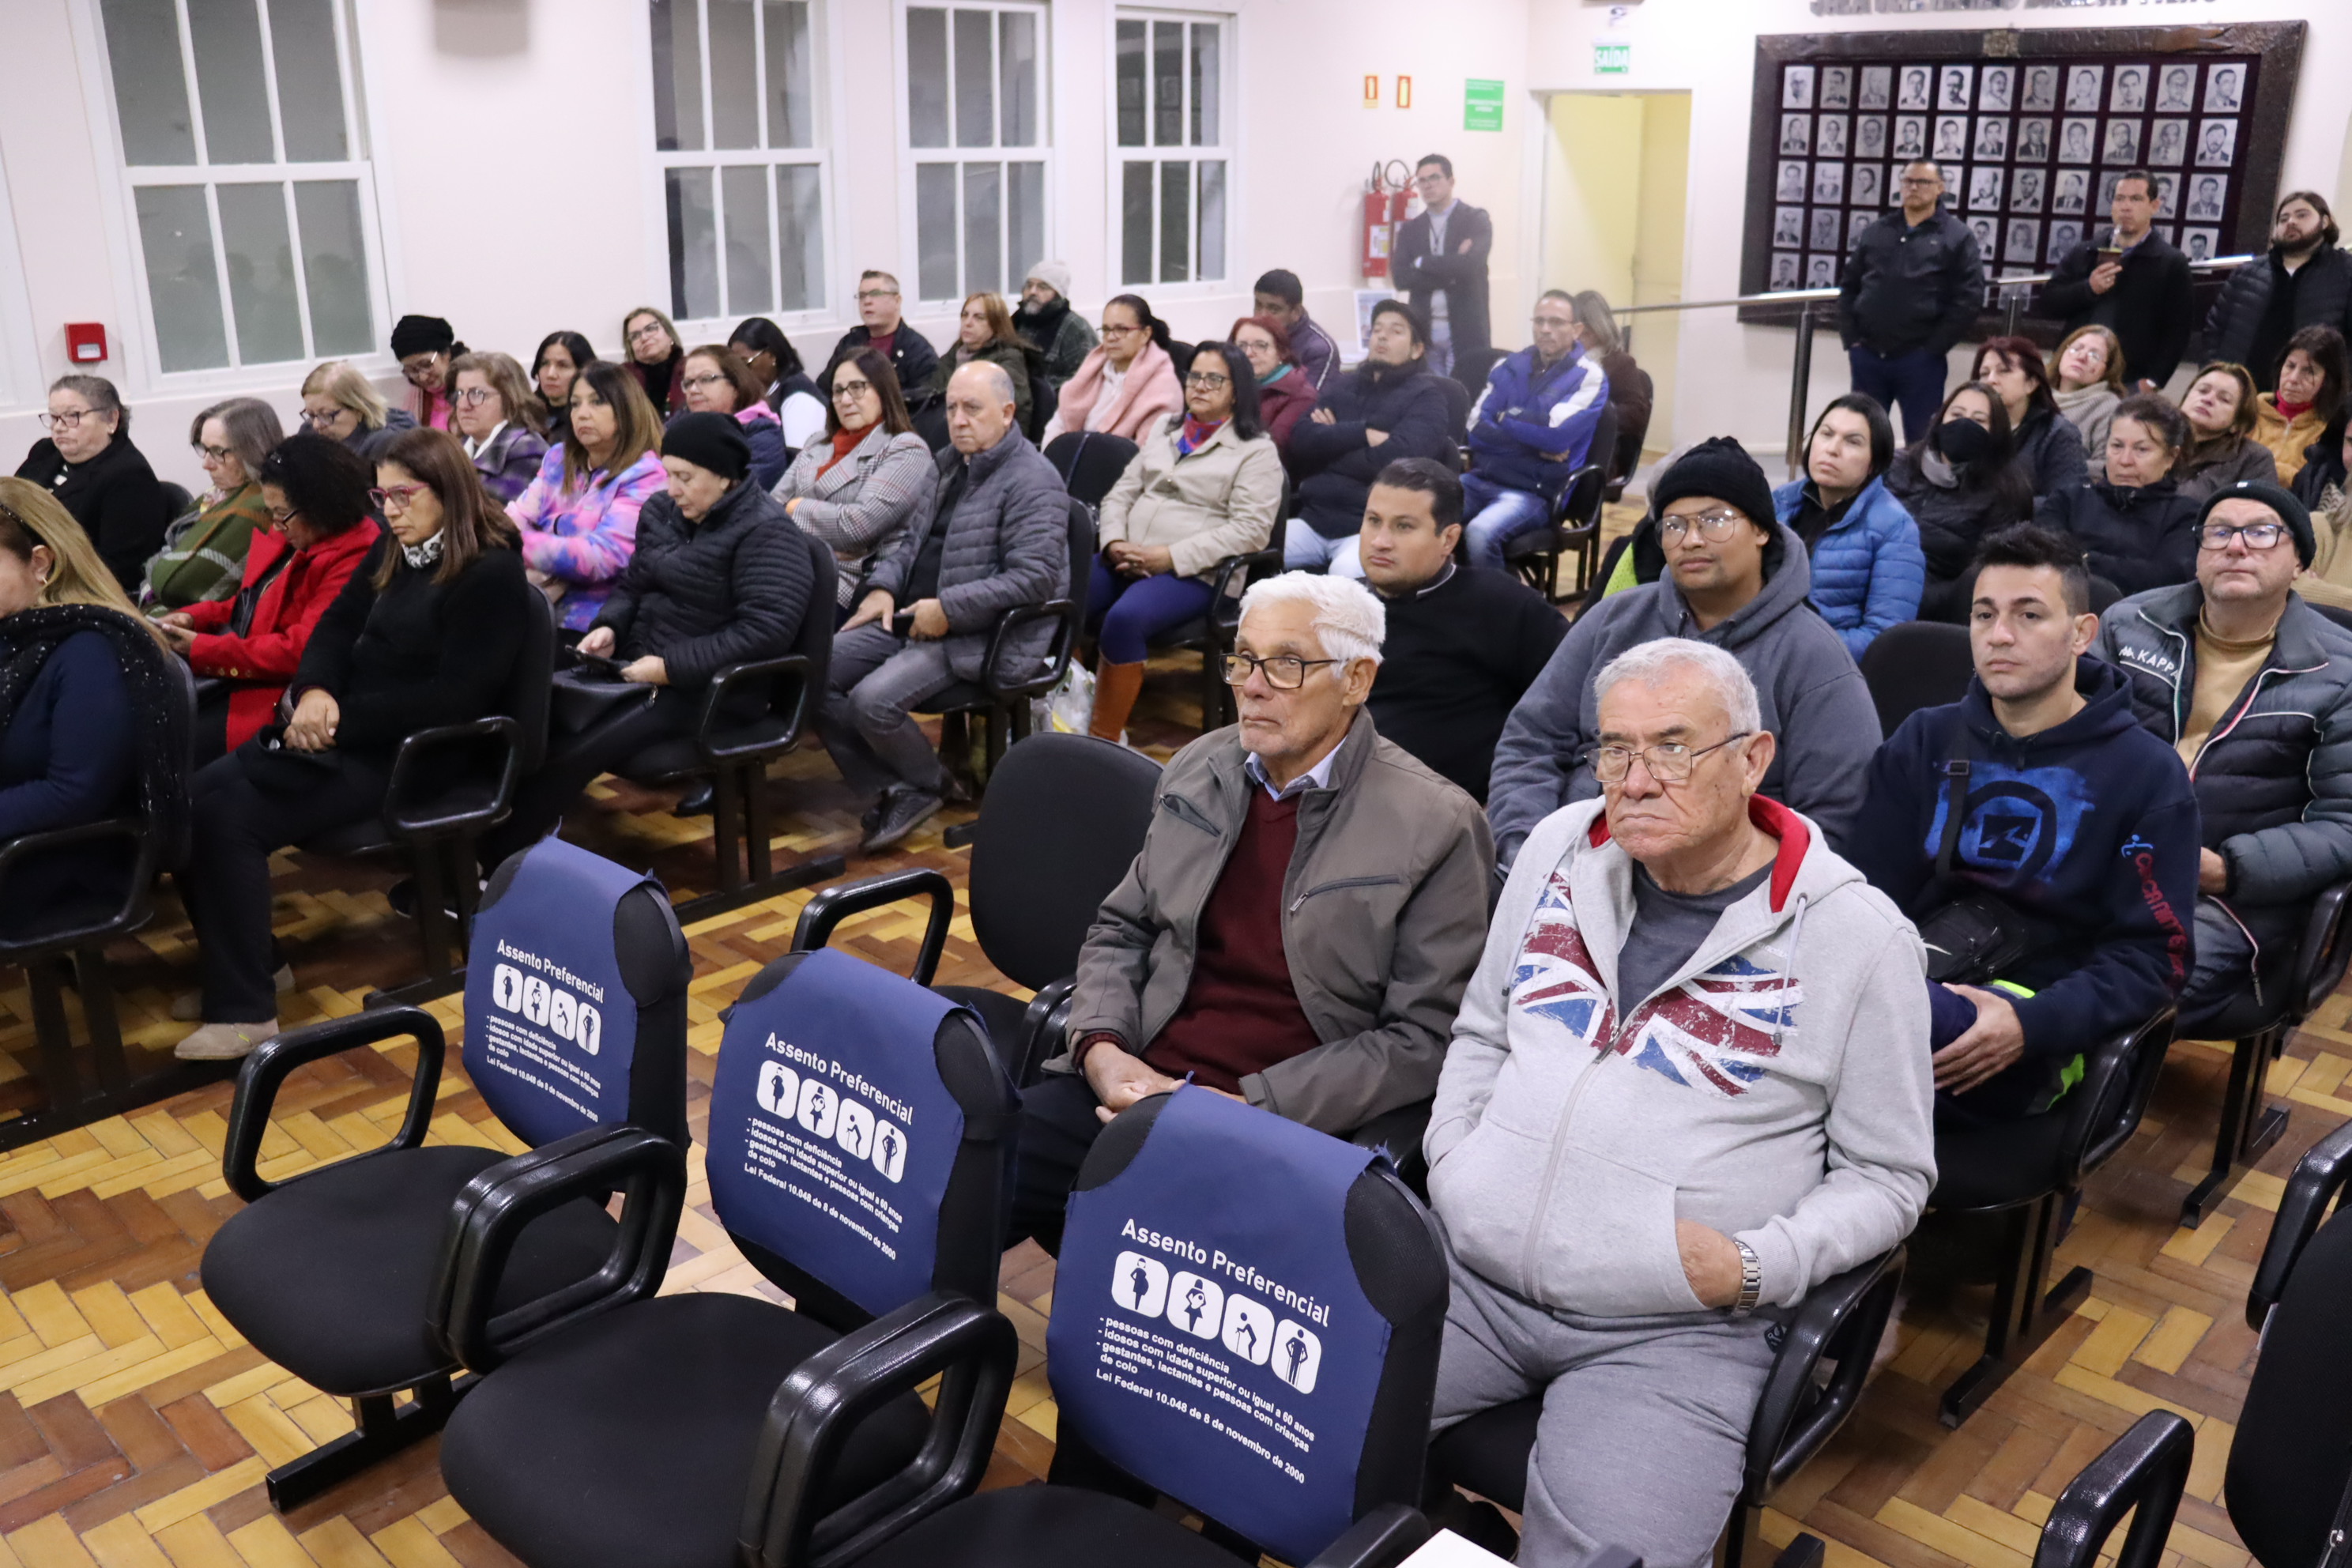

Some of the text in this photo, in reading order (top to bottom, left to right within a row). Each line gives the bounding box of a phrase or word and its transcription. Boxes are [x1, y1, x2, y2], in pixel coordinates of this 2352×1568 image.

[496, 938, 604, 1004] Assento Preferencial
[765, 1031, 913, 1125] Assento Preferencial
[747, 1148, 776, 1168] de colo
[749, 1139, 789, 1164] gestantes,
[790, 1156, 823, 1181] lactantes
[829, 1179, 858, 1202] pessoas
[859, 1197, 874, 1212] com
[874, 1208, 899, 1231] crianças
[751, 1126, 777, 1146] idosos
[778, 1141, 795, 1155] com
[796, 1148, 816, 1166] idade
[817, 1161, 847, 1182] superior
[848, 1178, 858, 1189] ou
[858, 1182, 875, 1200] igual
[874, 1196, 880, 1204] a
[880, 1198, 888, 1211] 60
[888, 1206, 903, 1223] anos
[752, 1118, 785, 1138] pessoas
[786, 1133, 802, 1147] com
[803, 1141, 842, 1168] deficiência
[744, 1162, 895, 1260] Lei Federal 10.048 de 8 de novembro de 2000
[1121, 1218, 1329, 1327] Assento Preferencial
[1100, 1353, 1138, 1374] de colo
[1104, 1328, 1139, 1348] idosos
[1141, 1344, 1163, 1358] com
[1166, 1351, 1194, 1370] idade
[1196, 1366, 1237, 1390] superior
[1238, 1386, 1250, 1399] ou
[1252, 1392, 1274, 1413] igual
[1275, 1408, 1281, 1418] a
[1282, 1412, 1293, 1426] 60
[1294, 1421, 1314, 1441] anos
[1106, 1317, 1149, 1339] pessoas
[1152, 1334, 1174, 1349] com
[1176, 1343, 1229, 1374] deficiência
[1096, 1368, 1304, 1483] Lei Federal 10.048 de 8 de novembro de 2000
[1102, 1342, 1155, 1369] gestantes,
[1158, 1360, 1203, 1388] lactantes
[1204, 1383, 1212, 1392] e
[1212, 1387, 1252, 1414] pessoas
[1253, 1409, 1273, 1427] com
[1274, 1423, 1309, 1453] crianças
